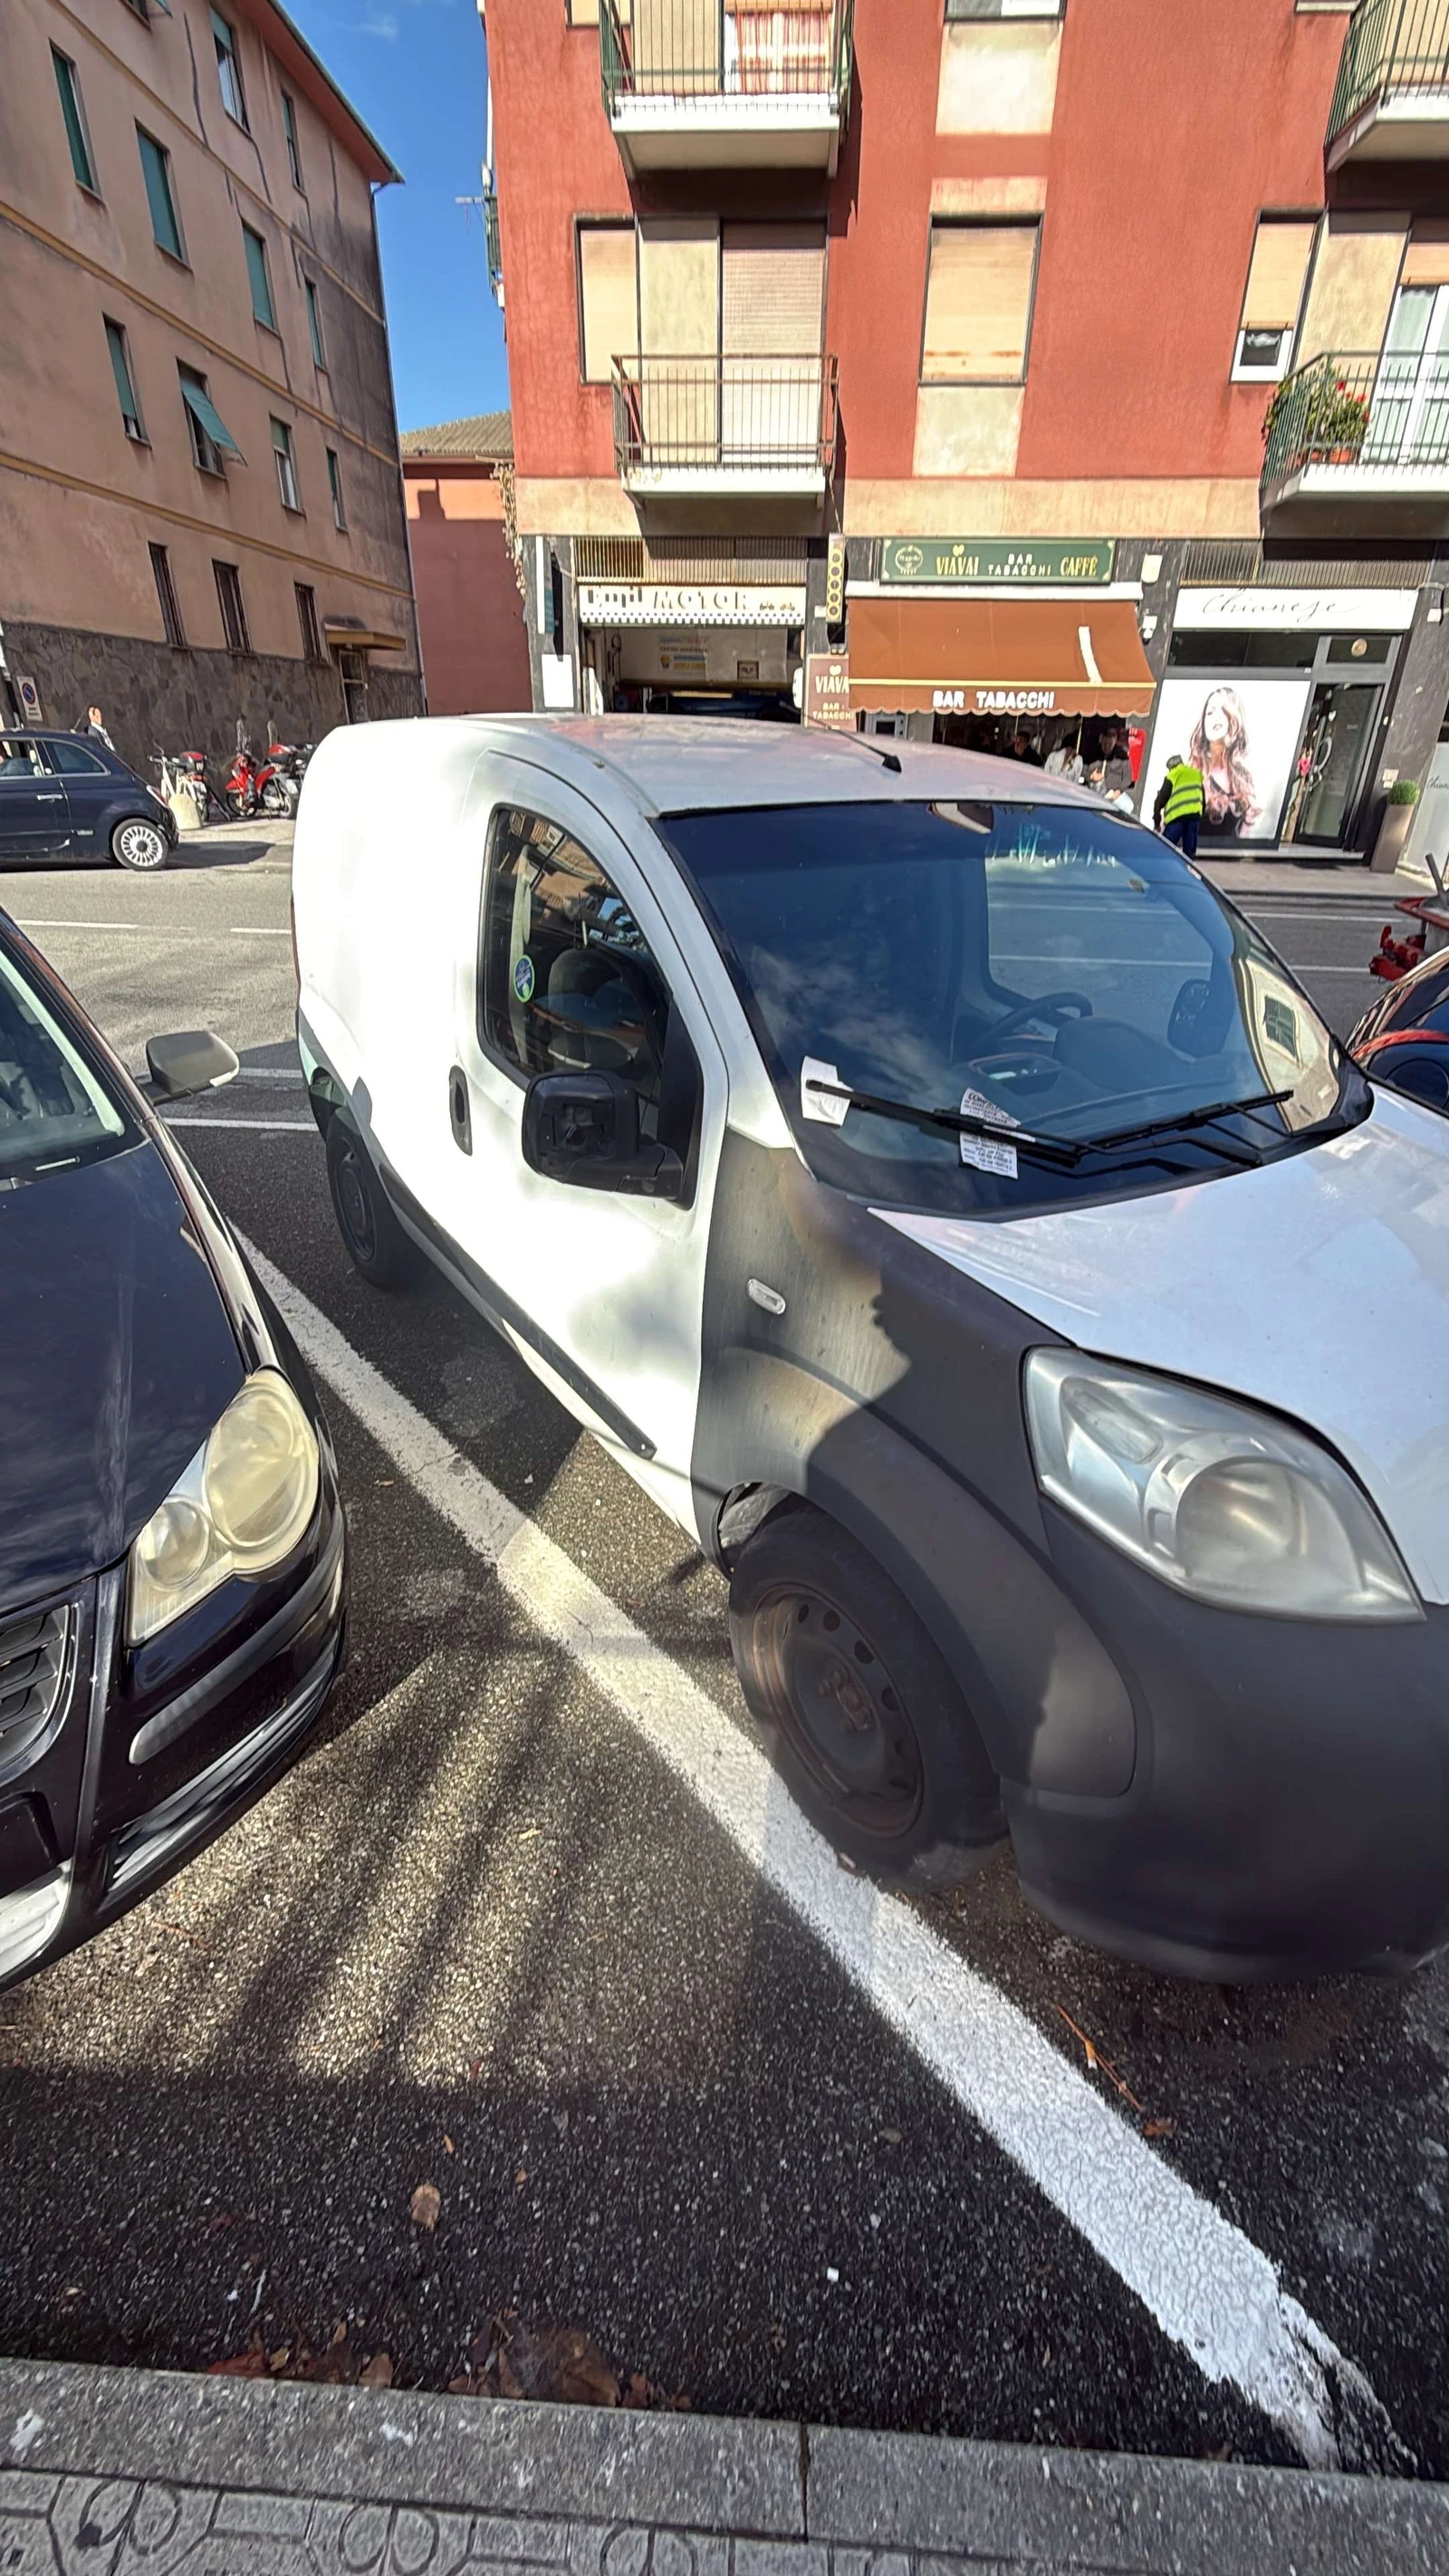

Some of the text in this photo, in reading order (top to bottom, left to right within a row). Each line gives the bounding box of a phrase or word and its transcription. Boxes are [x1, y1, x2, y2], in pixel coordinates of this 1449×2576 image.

[936, 556, 979, 575] VIAVAI
[1008, 553, 1033, 565] BAR
[988, 564, 1051, 576] TABACCHI
[653, 591, 753, 610] MOTOR
[815, 676, 849, 694] VIAVA
[822, 702, 840, 711] BAR
[933, 690, 1055, 708] BAR TABACCHI
